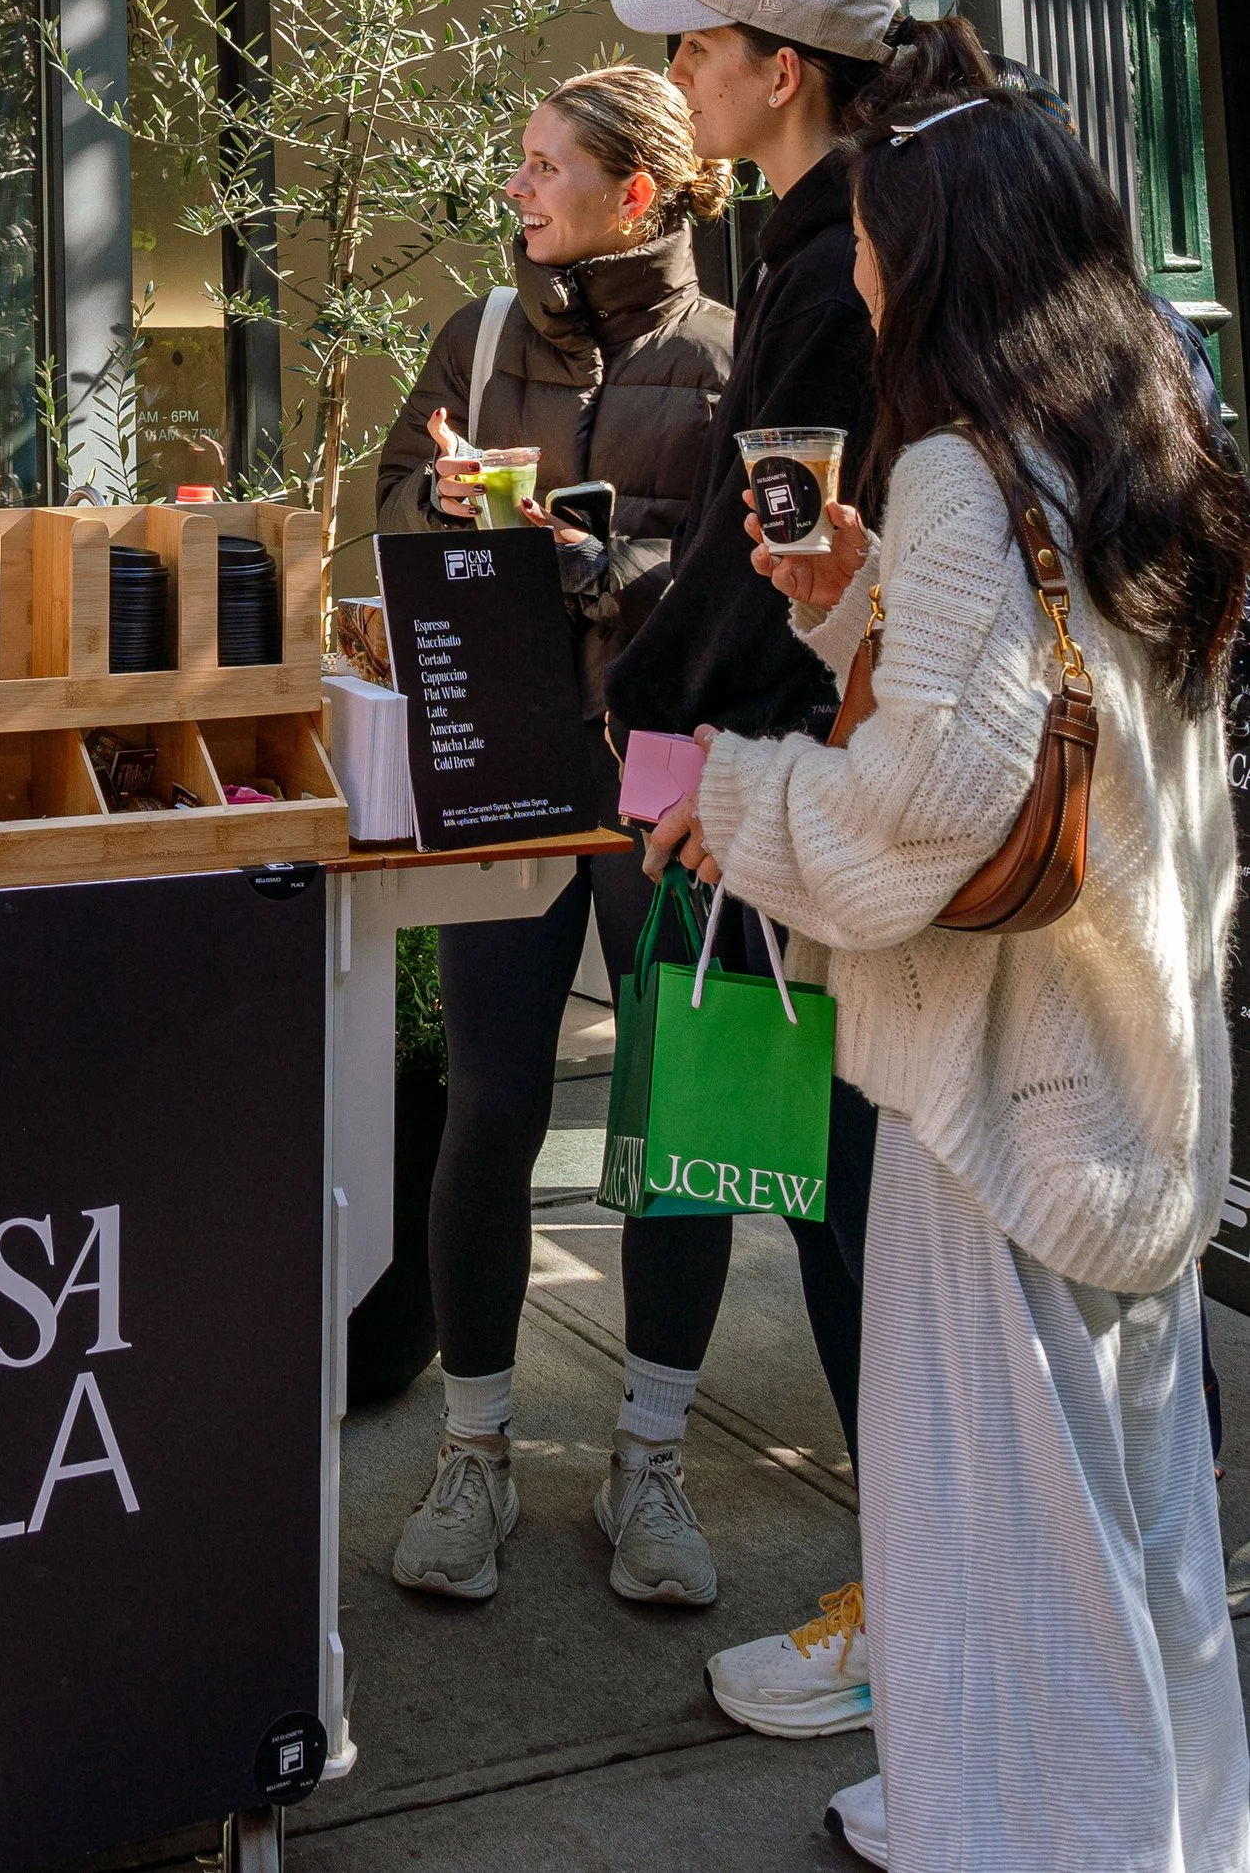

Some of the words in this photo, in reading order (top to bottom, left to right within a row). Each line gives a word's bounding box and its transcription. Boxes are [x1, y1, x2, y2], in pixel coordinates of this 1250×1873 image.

[171, 410, 199, 423] 6PM
[468, 549, 493, 564] CASA
[470, 563, 496, 577] FILA
[414, 619, 450, 634] Espresso
[419, 652, 451, 666] Cortado
[421, 668, 468, 686] Cappuccino
[424, 688, 441, 701] Flat
[441, 686, 467, 699] White
[426, 706, 448, 718] Latte
[430, 721, 474, 736] Americano
[432, 738, 463, 753] Matcha
[463, 737, 485, 750] Latte
[434, 756, 453, 771] Cold
[453, 756, 475, 769] Brew
[442, 809, 455, 817] Add
[468, 805, 492, 814] Caramel
[512, 800, 531, 809] Vanilla
[531, 798, 548, 807] Syrup
[443, 819, 456, 827] Milk
[480, 814, 498, 823] Whole
[513, 809, 535, 819] Almond
[549, 806, 560, 814] Oat
[649, 1154, 824, 1216] J.CREW
[649, 1451, 674, 1467] HOKA
